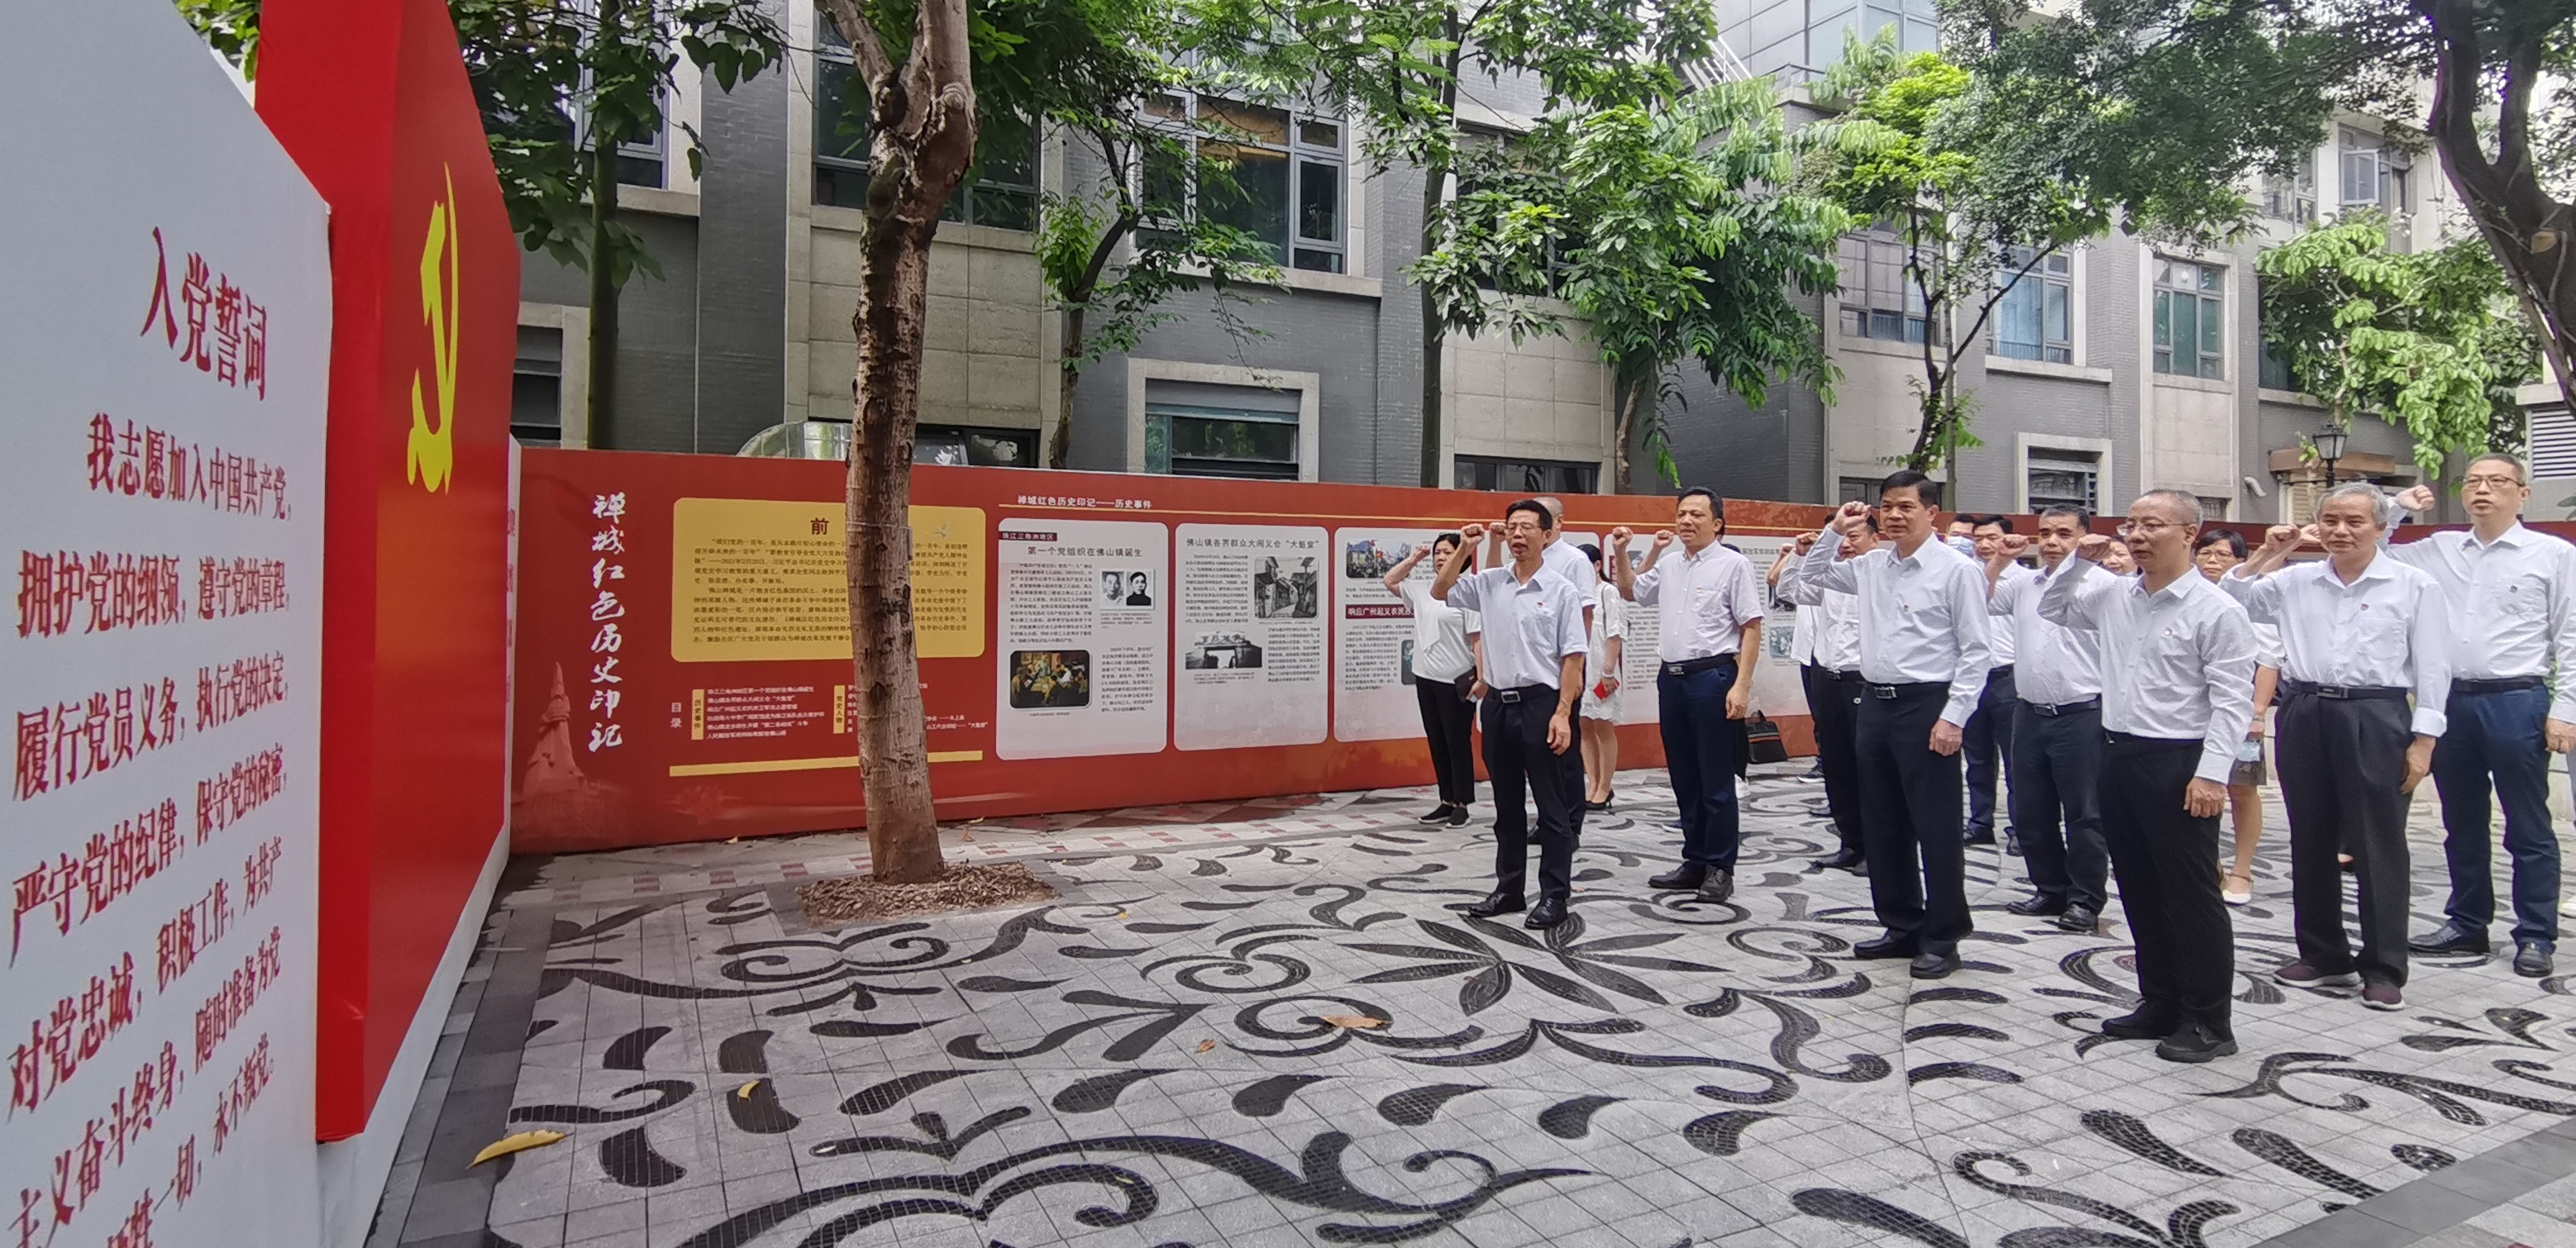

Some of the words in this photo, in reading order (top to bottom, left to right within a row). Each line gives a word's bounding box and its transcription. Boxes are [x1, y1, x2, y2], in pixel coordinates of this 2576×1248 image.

[140, 226, 266, 401] 入党誓词
[88, 412, 291, 522] 我志愿加入中国共产党，
[810, 517, 829, 535] 前
[1018, 495, 1152, 509] 禅城红色历史印记——历史事件
[17, 550, 289, 639] 拥护党的纲领，遵守党的章程，
[589, 492, 626, 752] 禅城红色历史印记
[1027, 546, 1143, 558] 第一个党组织在佛山镇诞生
[12, 650, 289, 801] 履行党员义务，执行党的决定，
[9, 741, 287, 969] 严守党的纪律，保守党的秘密，
[7, 836, 281, 1123] 对党忠诚，积极工作，为共产
[7, 926, 280, 1248] 主义奋斗终身，随时准备为党
